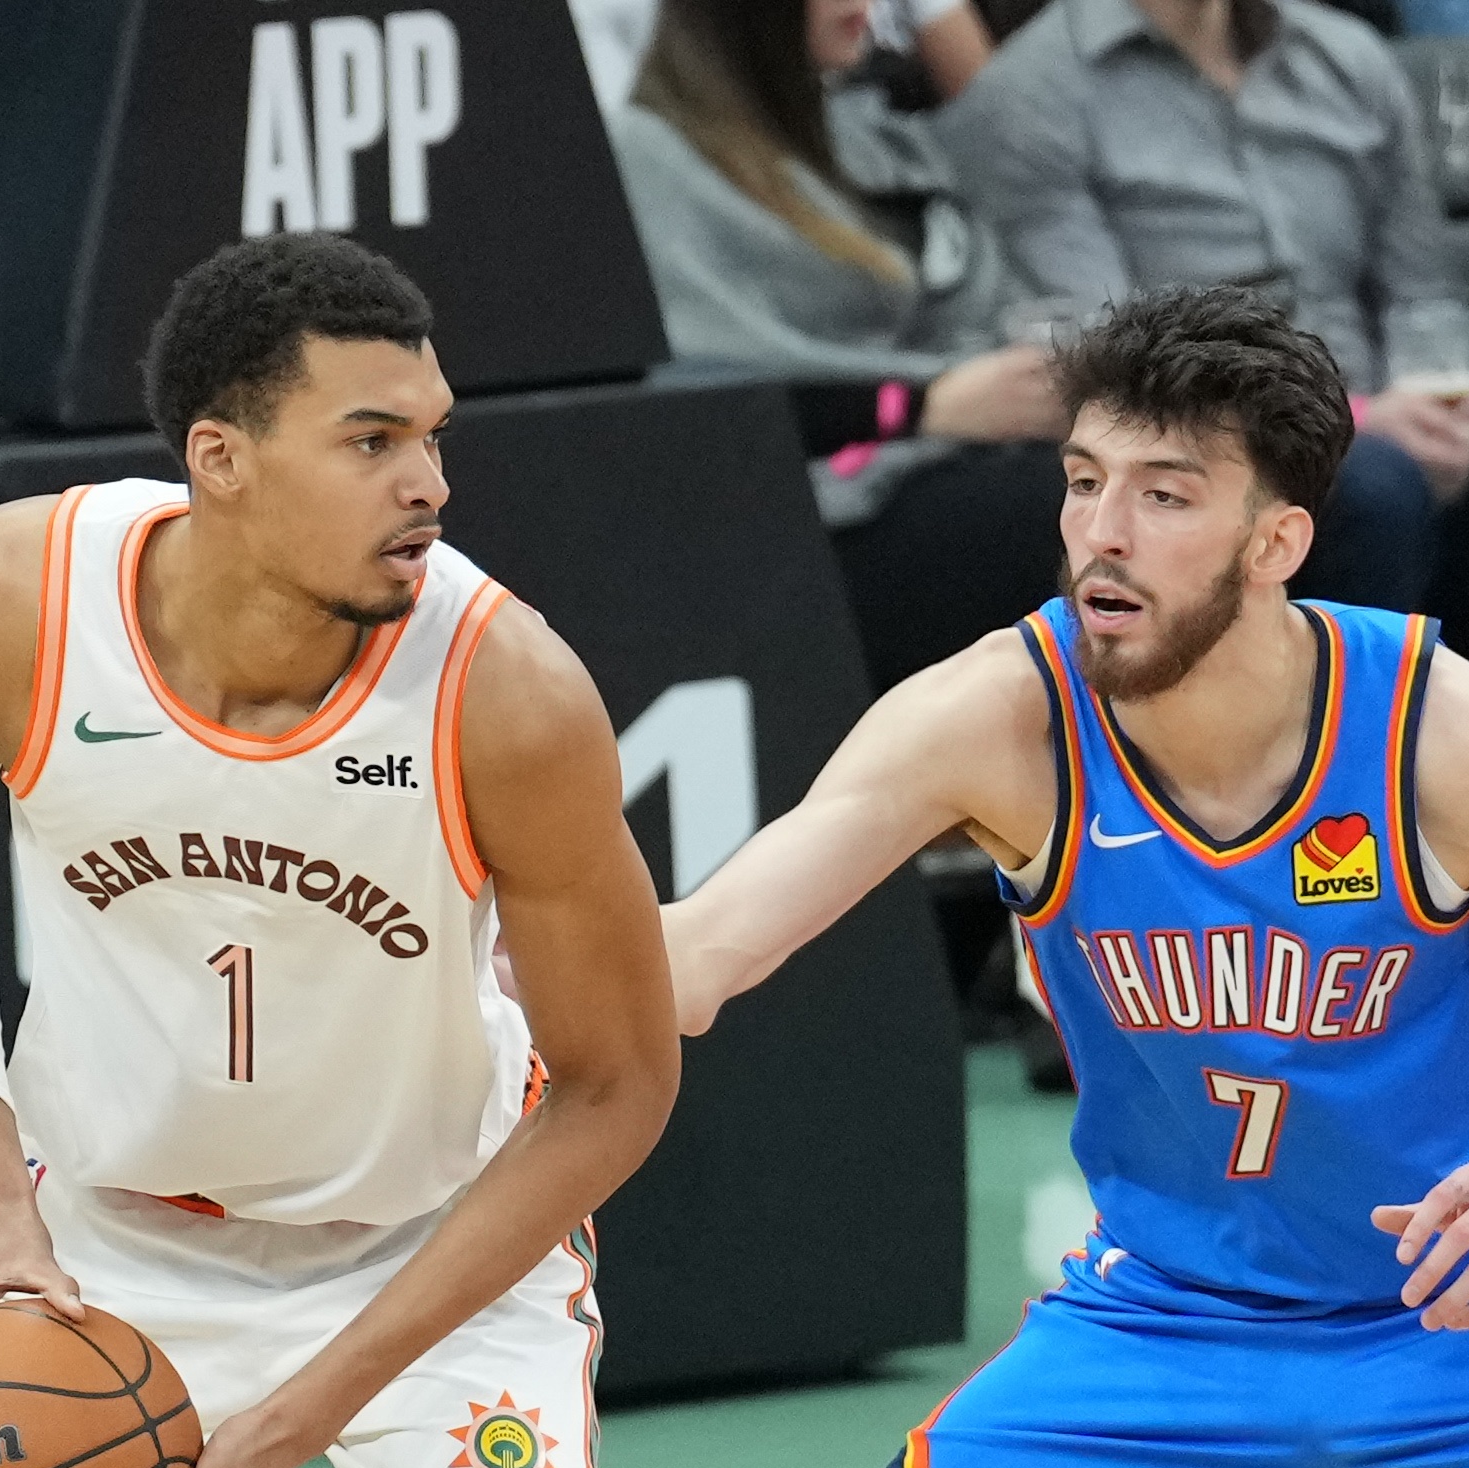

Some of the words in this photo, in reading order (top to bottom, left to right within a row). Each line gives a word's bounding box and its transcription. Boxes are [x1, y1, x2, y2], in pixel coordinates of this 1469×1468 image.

[241, 10, 462, 238] APP
[334, 754, 419, 788] Self.
[63, 834, 173, 912] SAN
[179, 832, 430, 960] ANTONIO
[205, 943, 254, 1083] 1
[1203, 1069, 1288, 1179] 7
